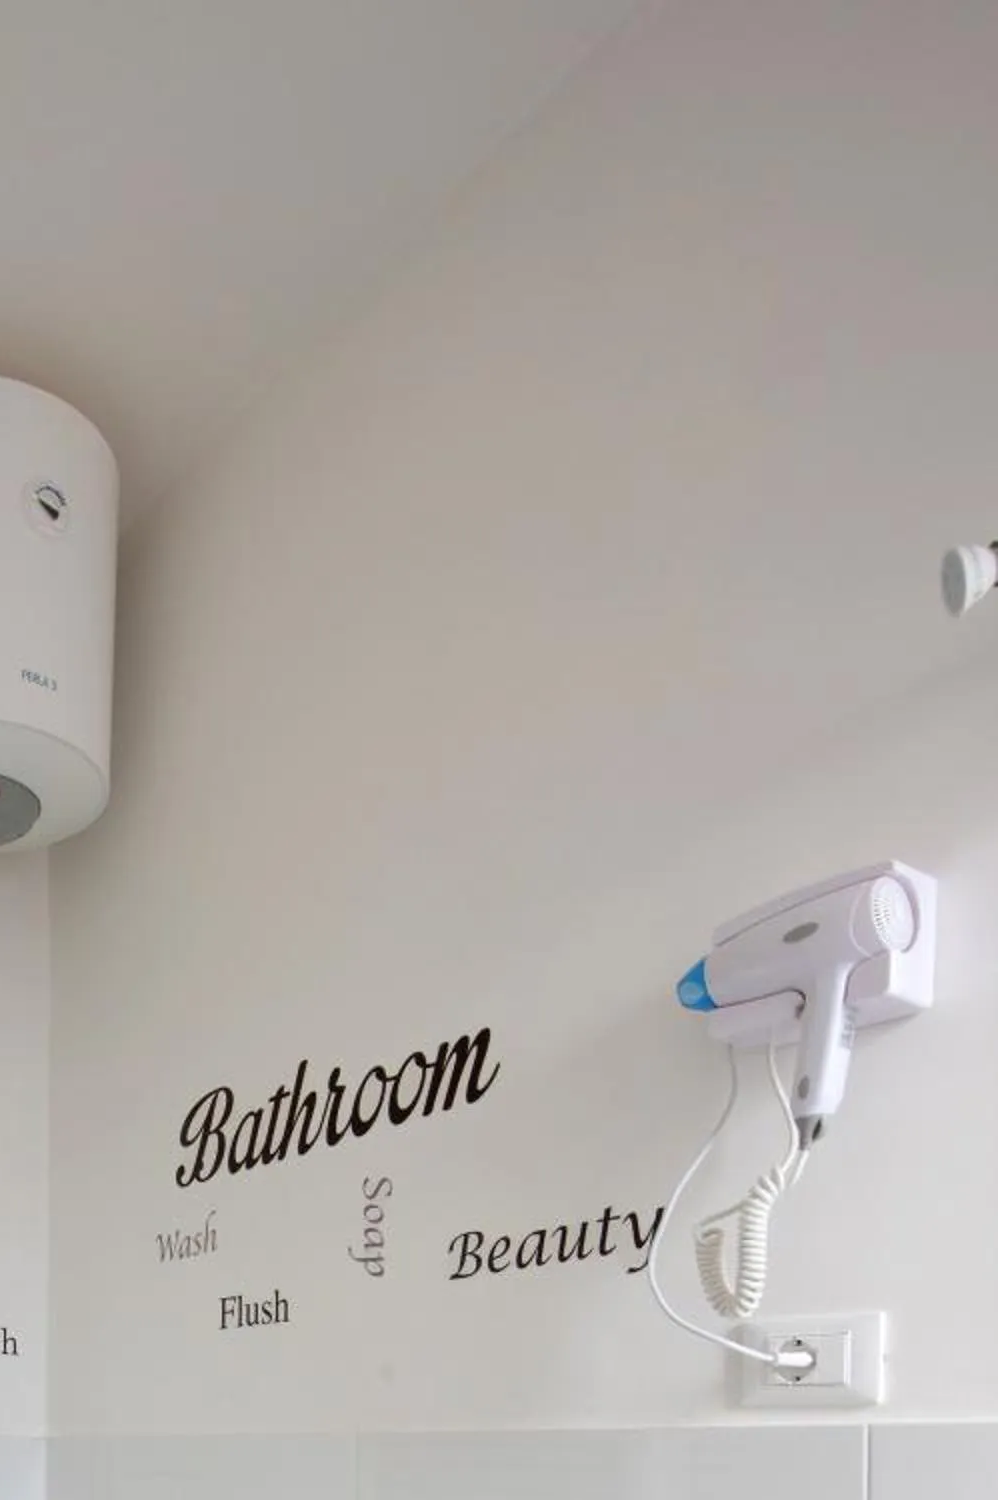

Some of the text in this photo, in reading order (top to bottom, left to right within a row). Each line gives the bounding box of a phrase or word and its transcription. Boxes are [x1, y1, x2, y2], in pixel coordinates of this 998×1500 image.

[175, 1027, 501, 1188] Bathroom
[155, 1210, 219, 1263] Wash
[347, 1175, 394, 1279] Soap
[448, 1205, 666, 1281] Beauty
[218, 1289, 291, 1330] Flush
